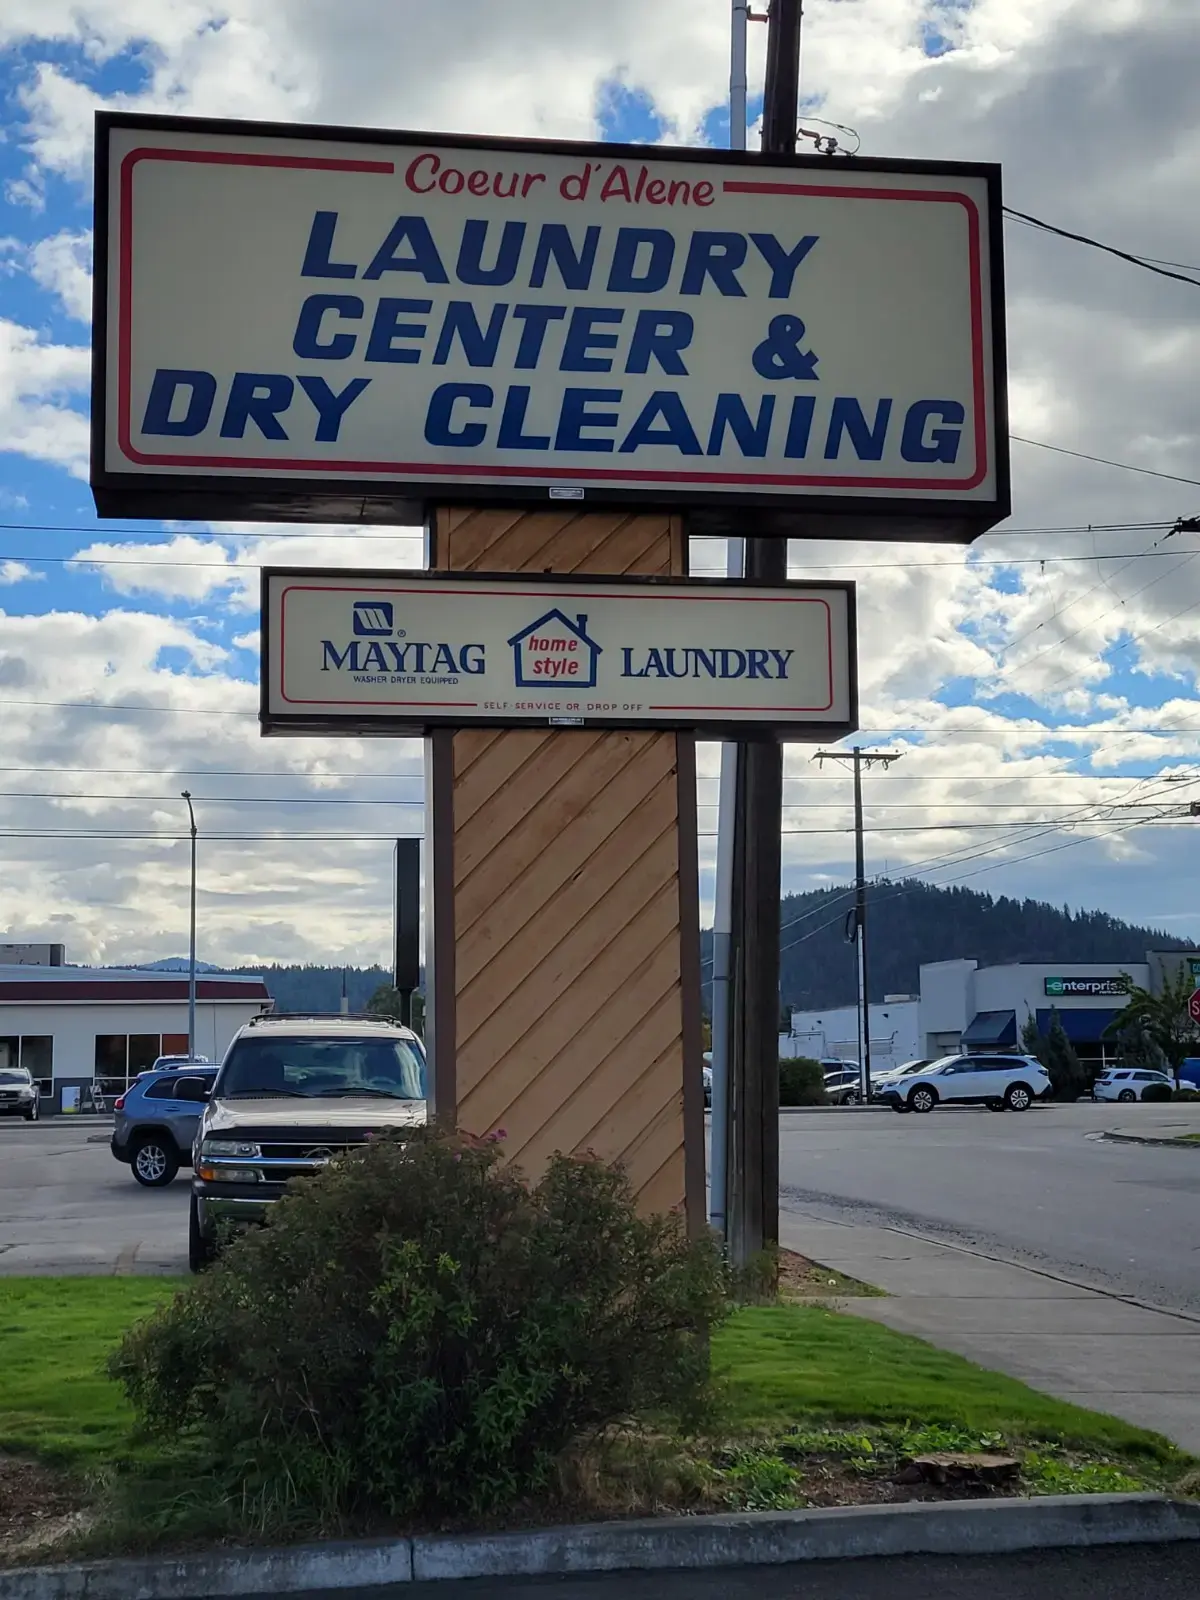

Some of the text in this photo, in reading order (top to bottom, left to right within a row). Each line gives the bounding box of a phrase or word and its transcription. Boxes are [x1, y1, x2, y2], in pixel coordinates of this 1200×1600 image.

[404, 153, 716, 206] Coeur d'Alene
[300, 210, 820, 299] LAUNDRY
[292, 293, 820, 381] CENTER &
[140, 368, 966, 464] DRY CLEANING
[320, 639, 486, 675] MAYTAG
[527, 634, 579, 653] home
[352, 674, 459, 686] WASHER DRYER EQUIPPED
[531, 656, 580, 679] style
[620, 646, 796, 680] LAUNDRY
[566, 702, 580, 712] OR
[586, 703, 618, 713] DROP
[622, 703, 644, 713] OFF
